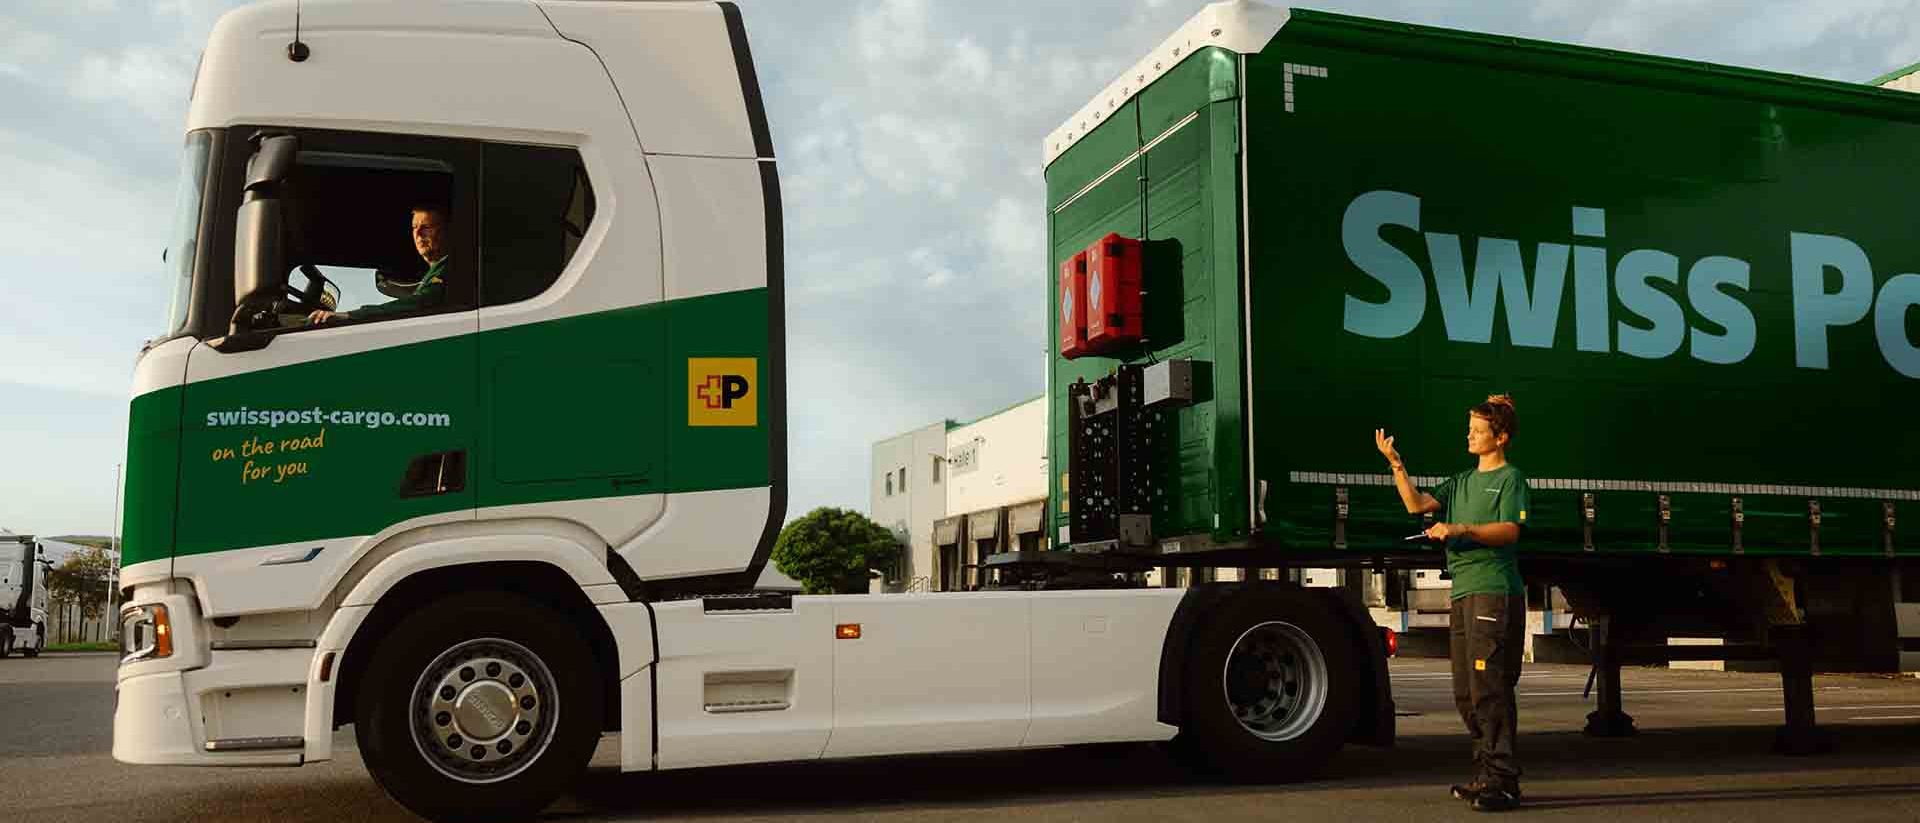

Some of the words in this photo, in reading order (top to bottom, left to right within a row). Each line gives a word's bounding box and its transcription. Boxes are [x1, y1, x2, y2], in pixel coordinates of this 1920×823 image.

[1342, 190, 1757, 365] Swiss
[207, 407, 450, 429] swisspost-cargo.com
[212, 449, 235, 461] on
[241, 437, 274, 457] the
[280, 427, 325, 450] road
[242, 460, 272, 484] for
[274, 461, 308, 483] you
